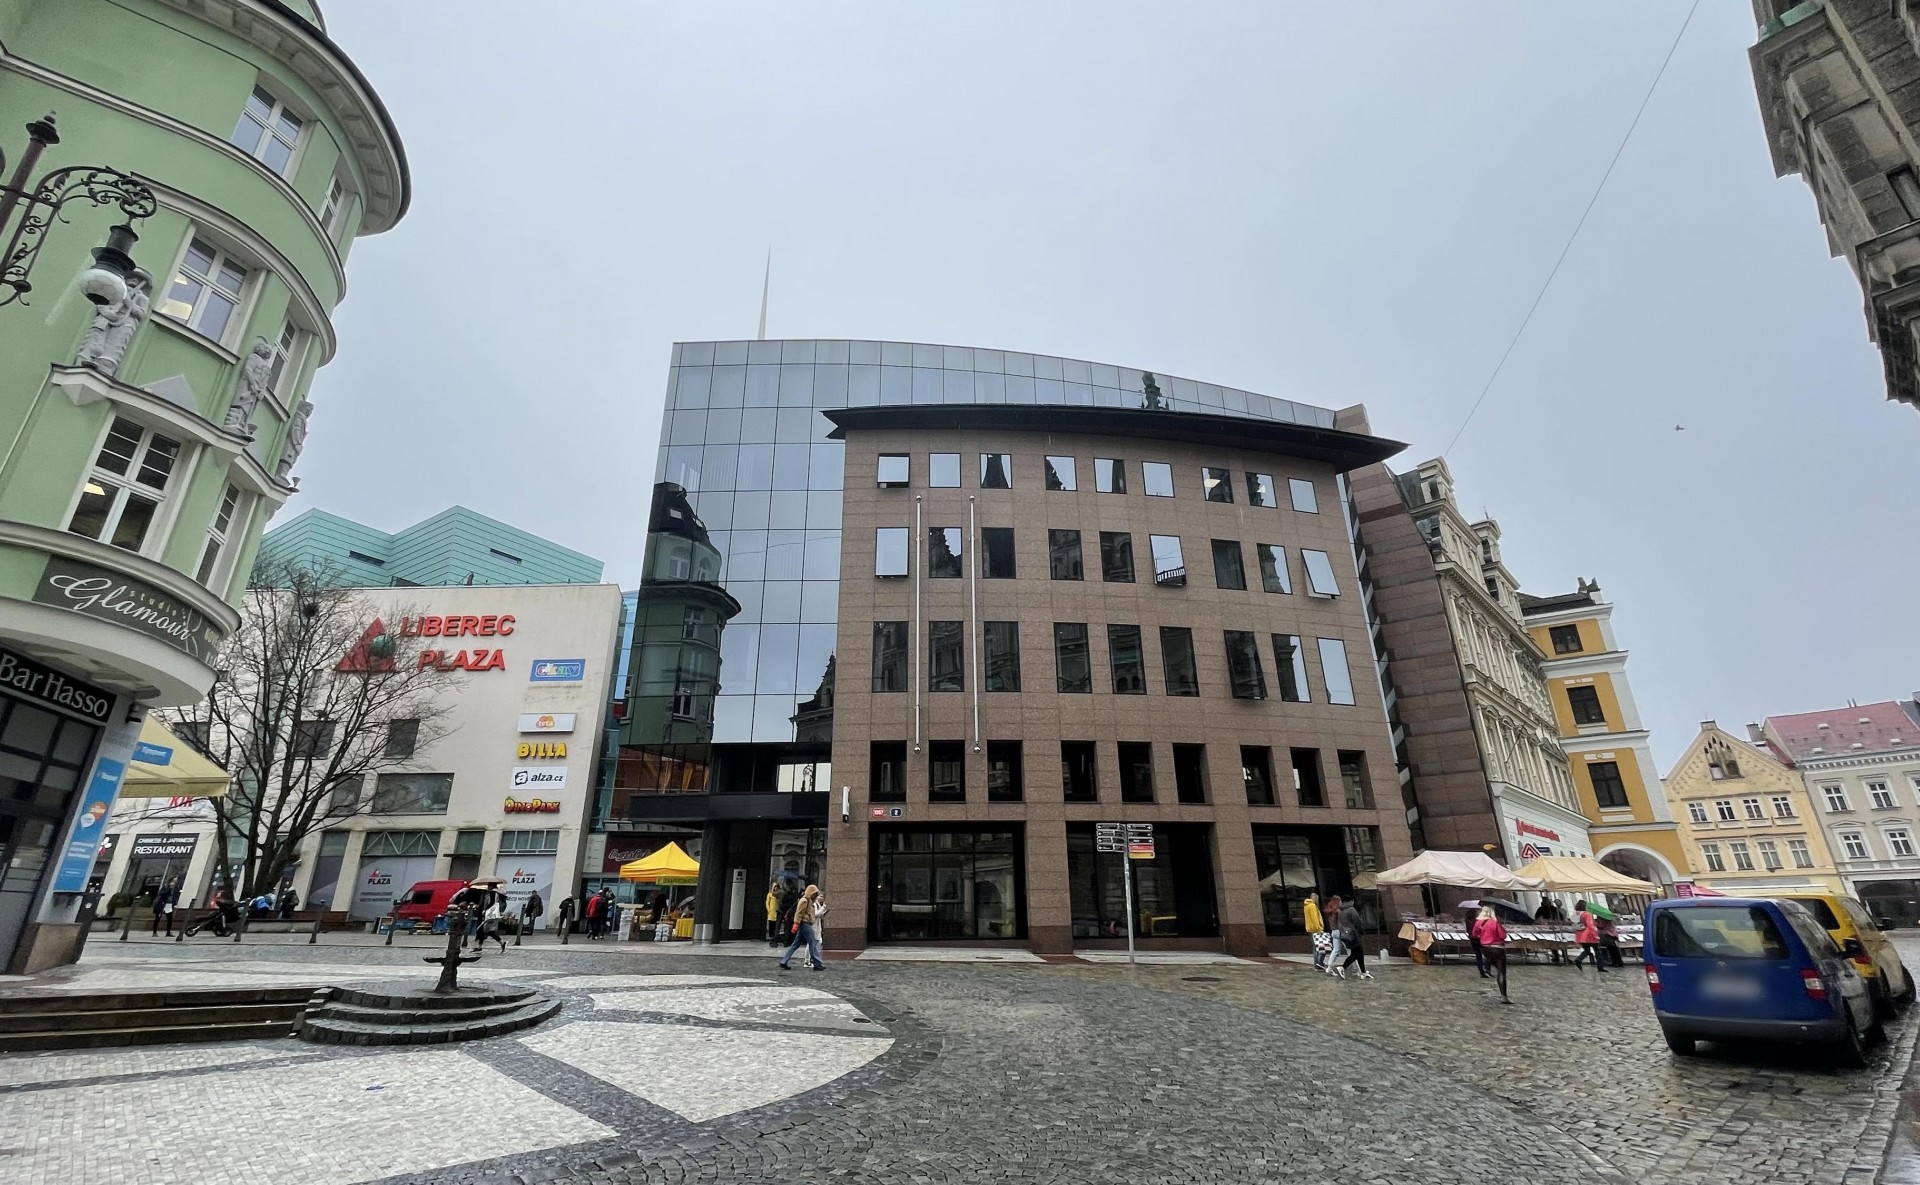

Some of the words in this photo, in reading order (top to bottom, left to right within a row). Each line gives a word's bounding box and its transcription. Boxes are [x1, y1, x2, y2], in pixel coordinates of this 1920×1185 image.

[50, 575, 191, 641] Glamour
[400, 614, 516, 637] LIBEREC
[417, 648, 506, 672] PLAZA
[0, 653, 44, 691] Bar
[41, 672, 108, 717] Hasso
[517, 742, 567, 759] BILLA
[530, 772, 564, 782] alza.cz
[133, 845, 194, 855] RESTAURANT
